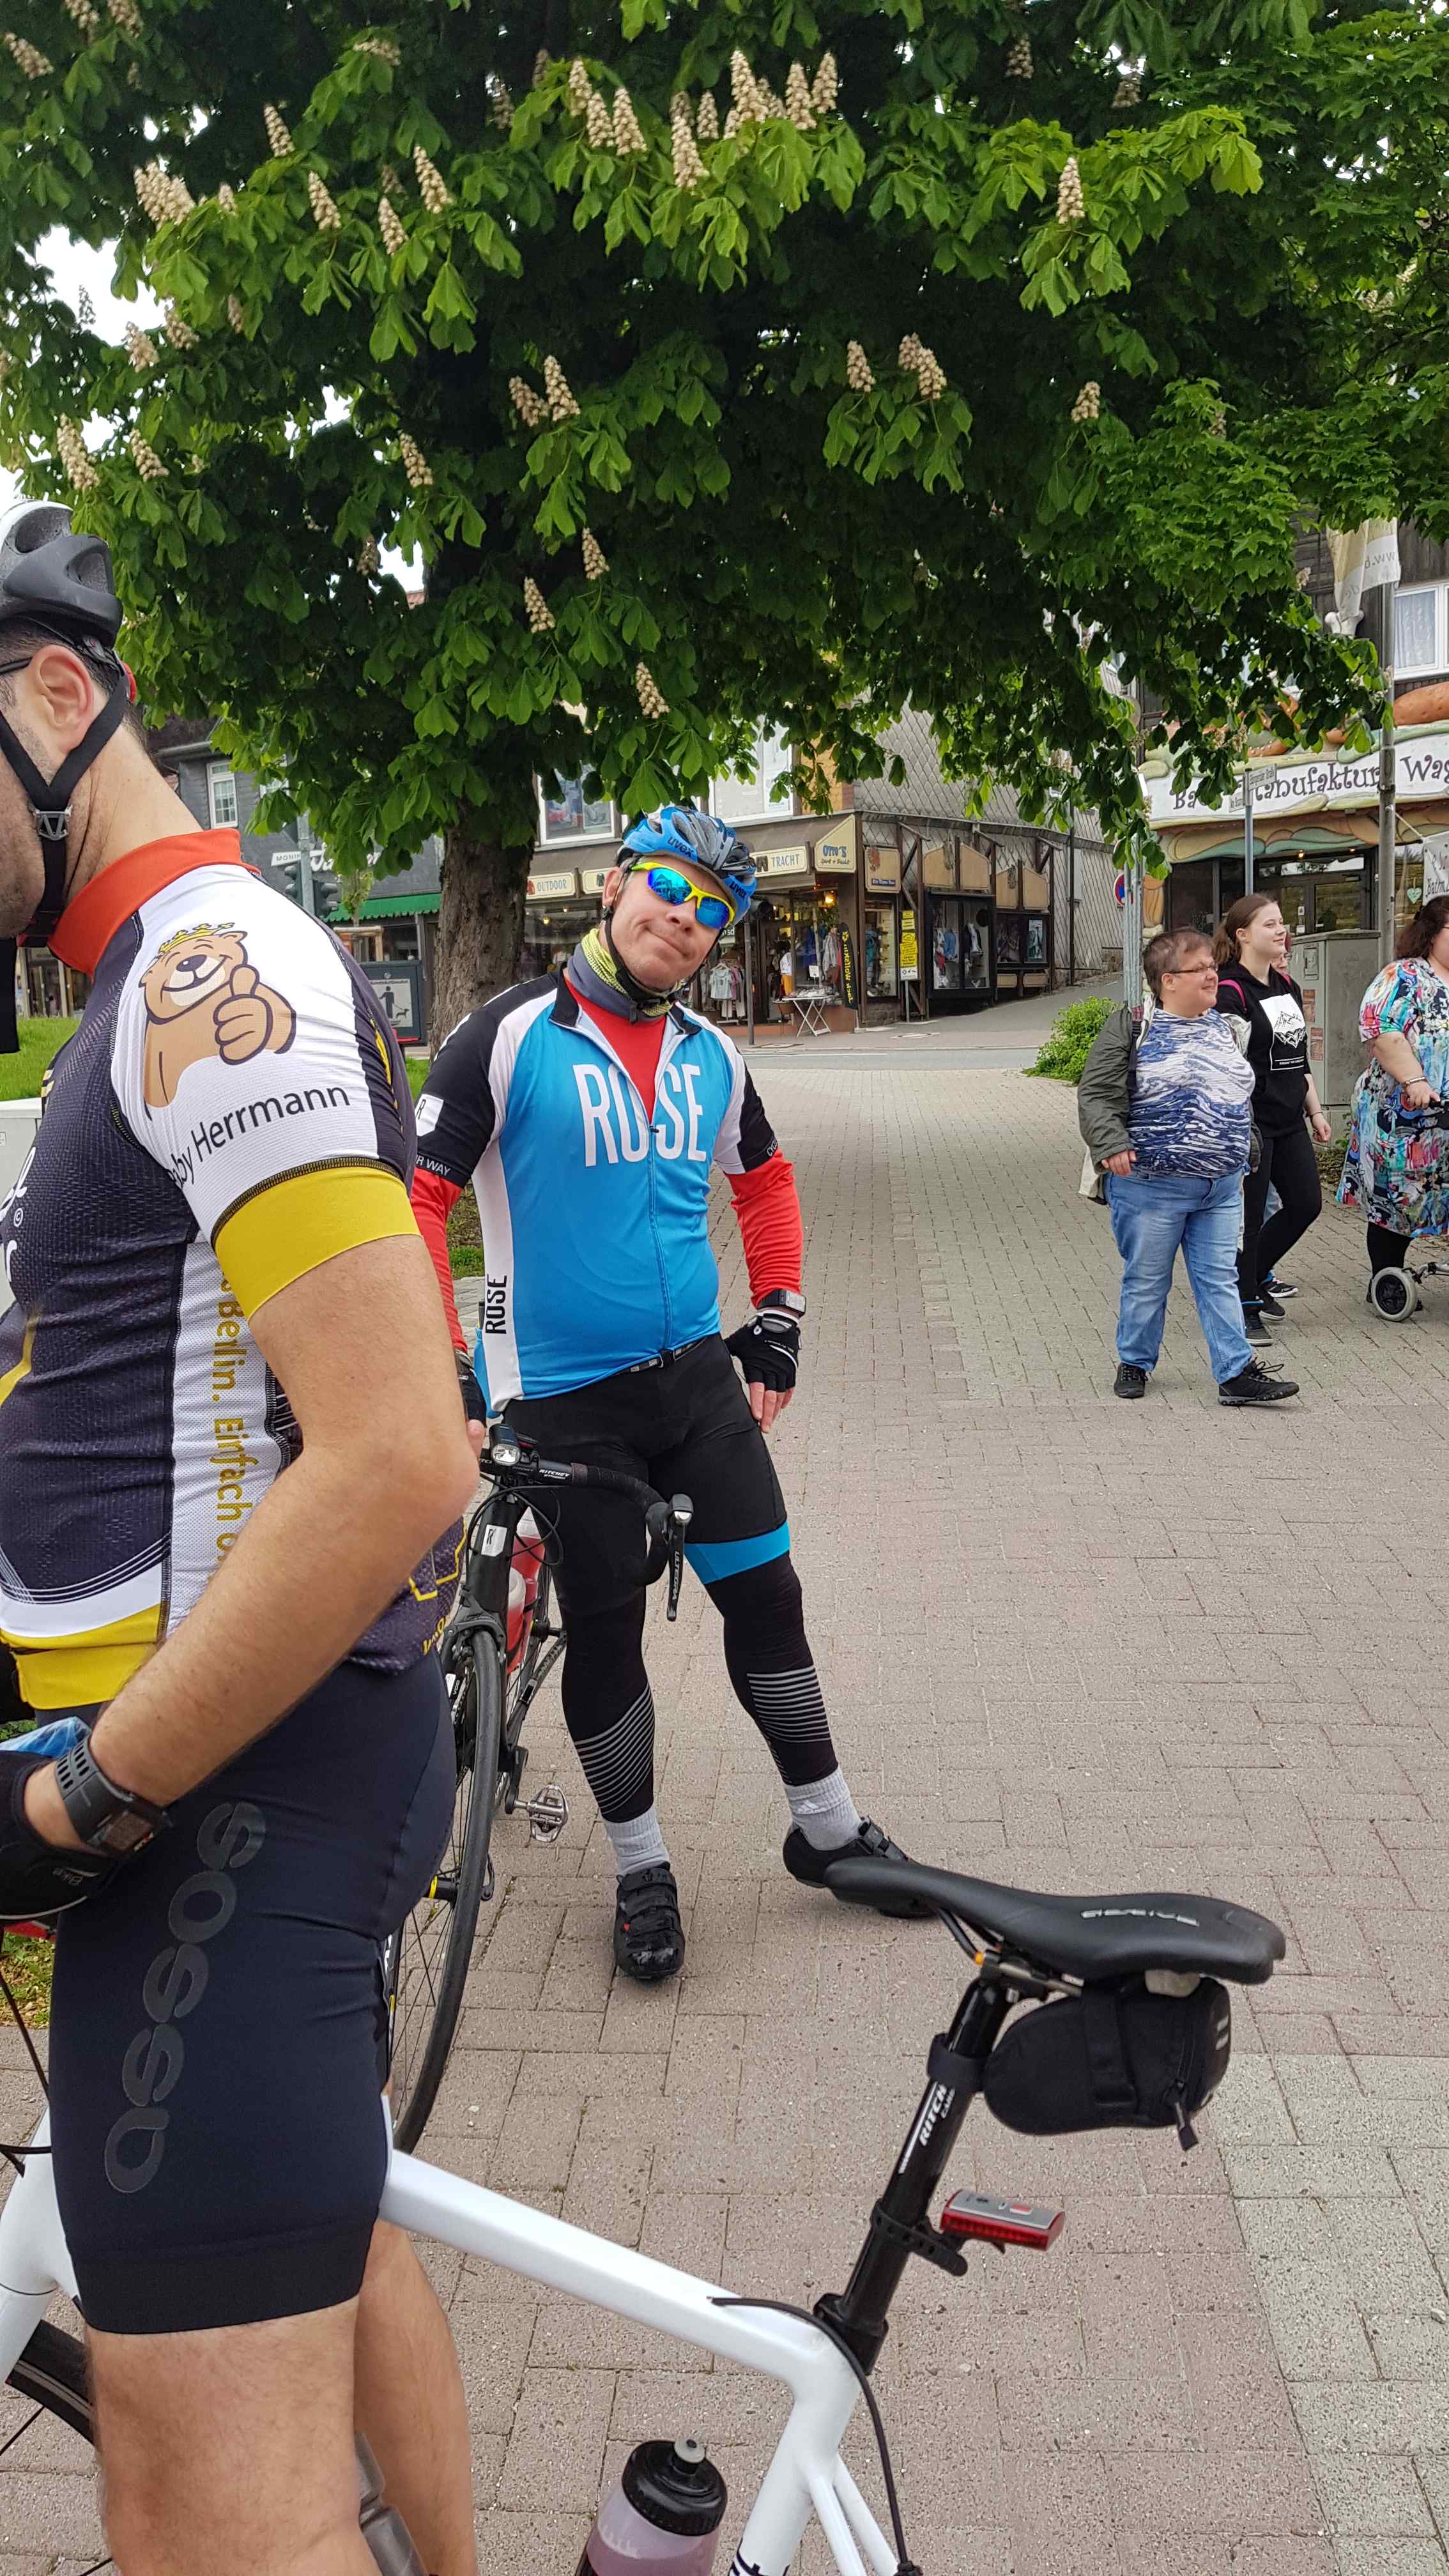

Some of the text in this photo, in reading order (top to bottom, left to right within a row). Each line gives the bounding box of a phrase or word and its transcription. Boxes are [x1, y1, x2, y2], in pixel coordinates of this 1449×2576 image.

[666, 836, 694, 858] uvex
[771, 853, 800, 868] TRACHT
[537, 878, 567, 892] OUTDOOR
[191, 1087, 351, 1162] Herrmann
[572, 1062, 707, 1167] ROSE
[426, 1158, 451, 1177] WAY
[486, 1273, 507, 1335] ROSE
[212, 1301, 247, 1402] Berlin.
[209, 1418, 259, 1521] Einfach
[539, 1469, 571, 1478] RITCHEY
[672, 1551, 680, 1600] ULTEGRA
[919, 2083, 947, 2147] RITCH
